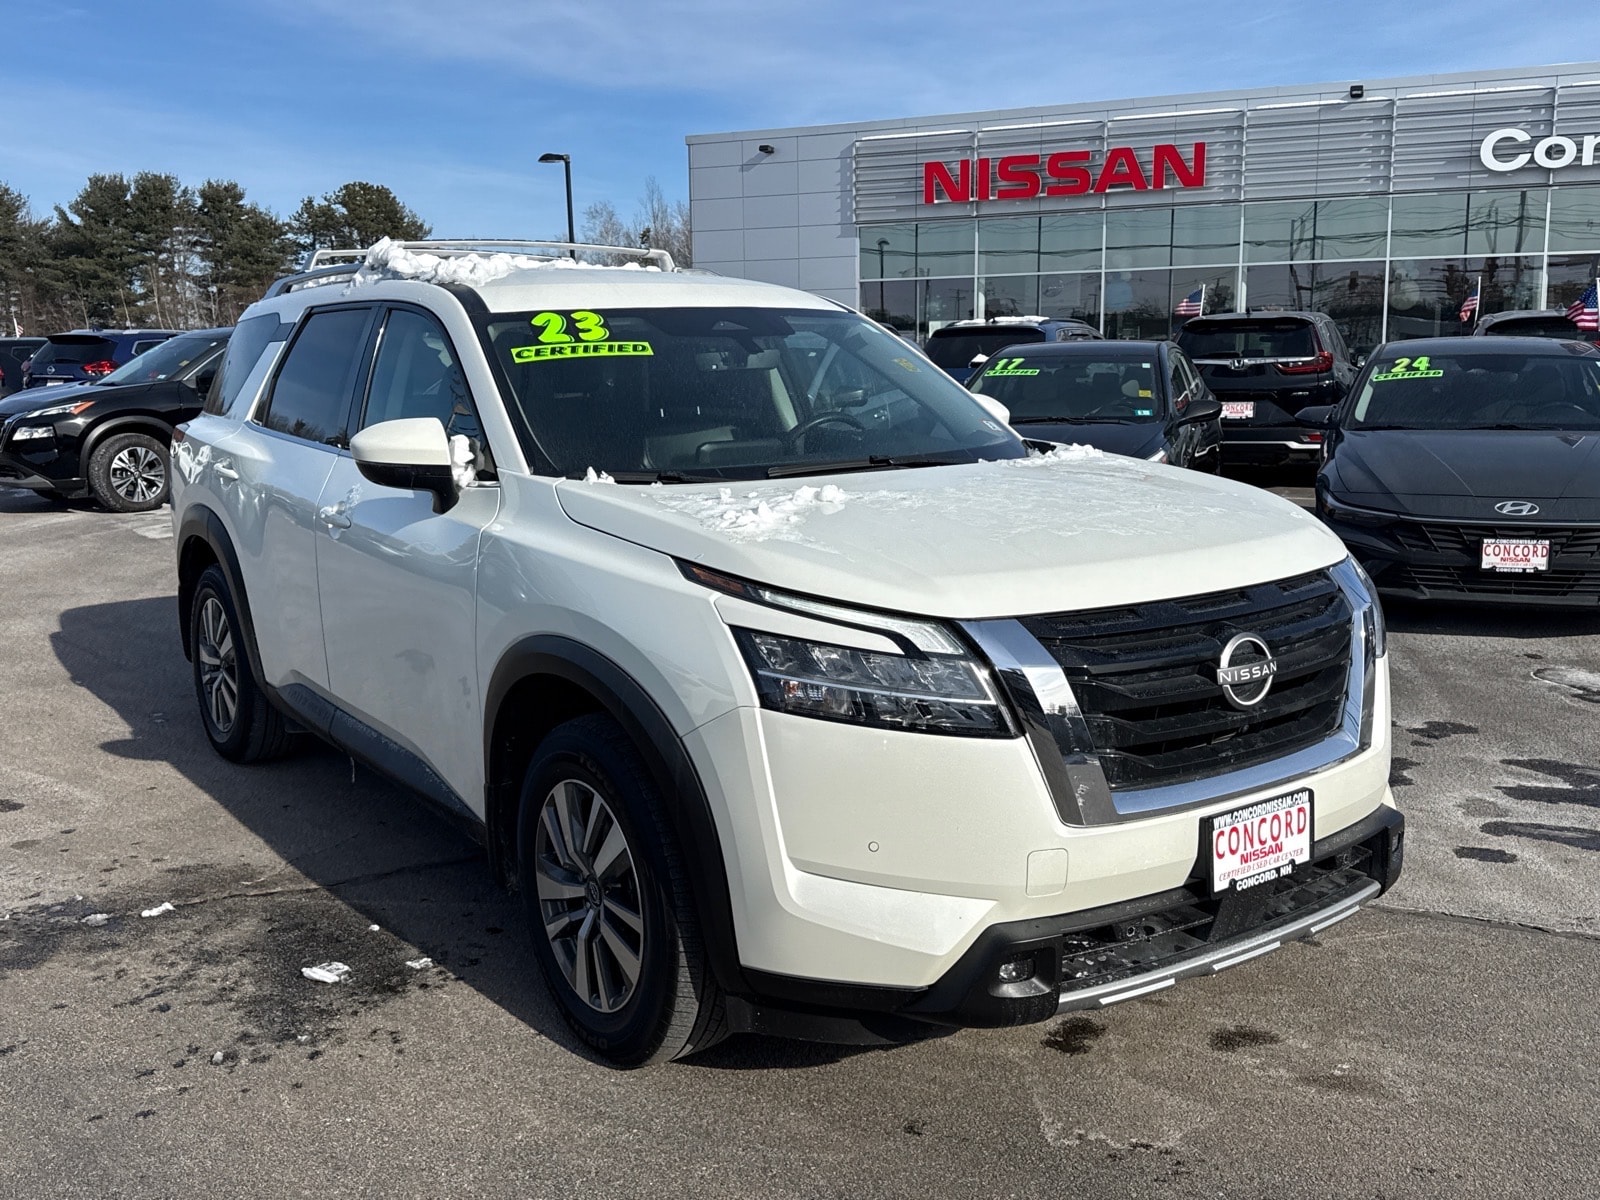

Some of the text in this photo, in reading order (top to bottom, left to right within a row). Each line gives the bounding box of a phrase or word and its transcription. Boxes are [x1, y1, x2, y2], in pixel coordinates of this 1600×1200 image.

[923, 141, 1207, 204] NISSAN
[530, 310, 610, 343] 23
[513, 343, 650, 361] CERTIFIED
[994, 357, 1026, 370] 17
[1374, 371, 1442, 380] CERTIFIED
[1390, 356, 1431, 373] 24
[1484, 544, 1549, 557] CONCORD
[1219, 660, 1278, 683] NISSAN
[1213, 790, 1309, 830] WWW.CONCORDNISSAN.COM
[1215, 806, 1307, 860] CONCORD
[1218, 847, 1304, 882] CERTIFIED USED CAR CENTER
[1240, 841, 1284, 866] NISSAN
[1280, 863, 1292, 877] NH
